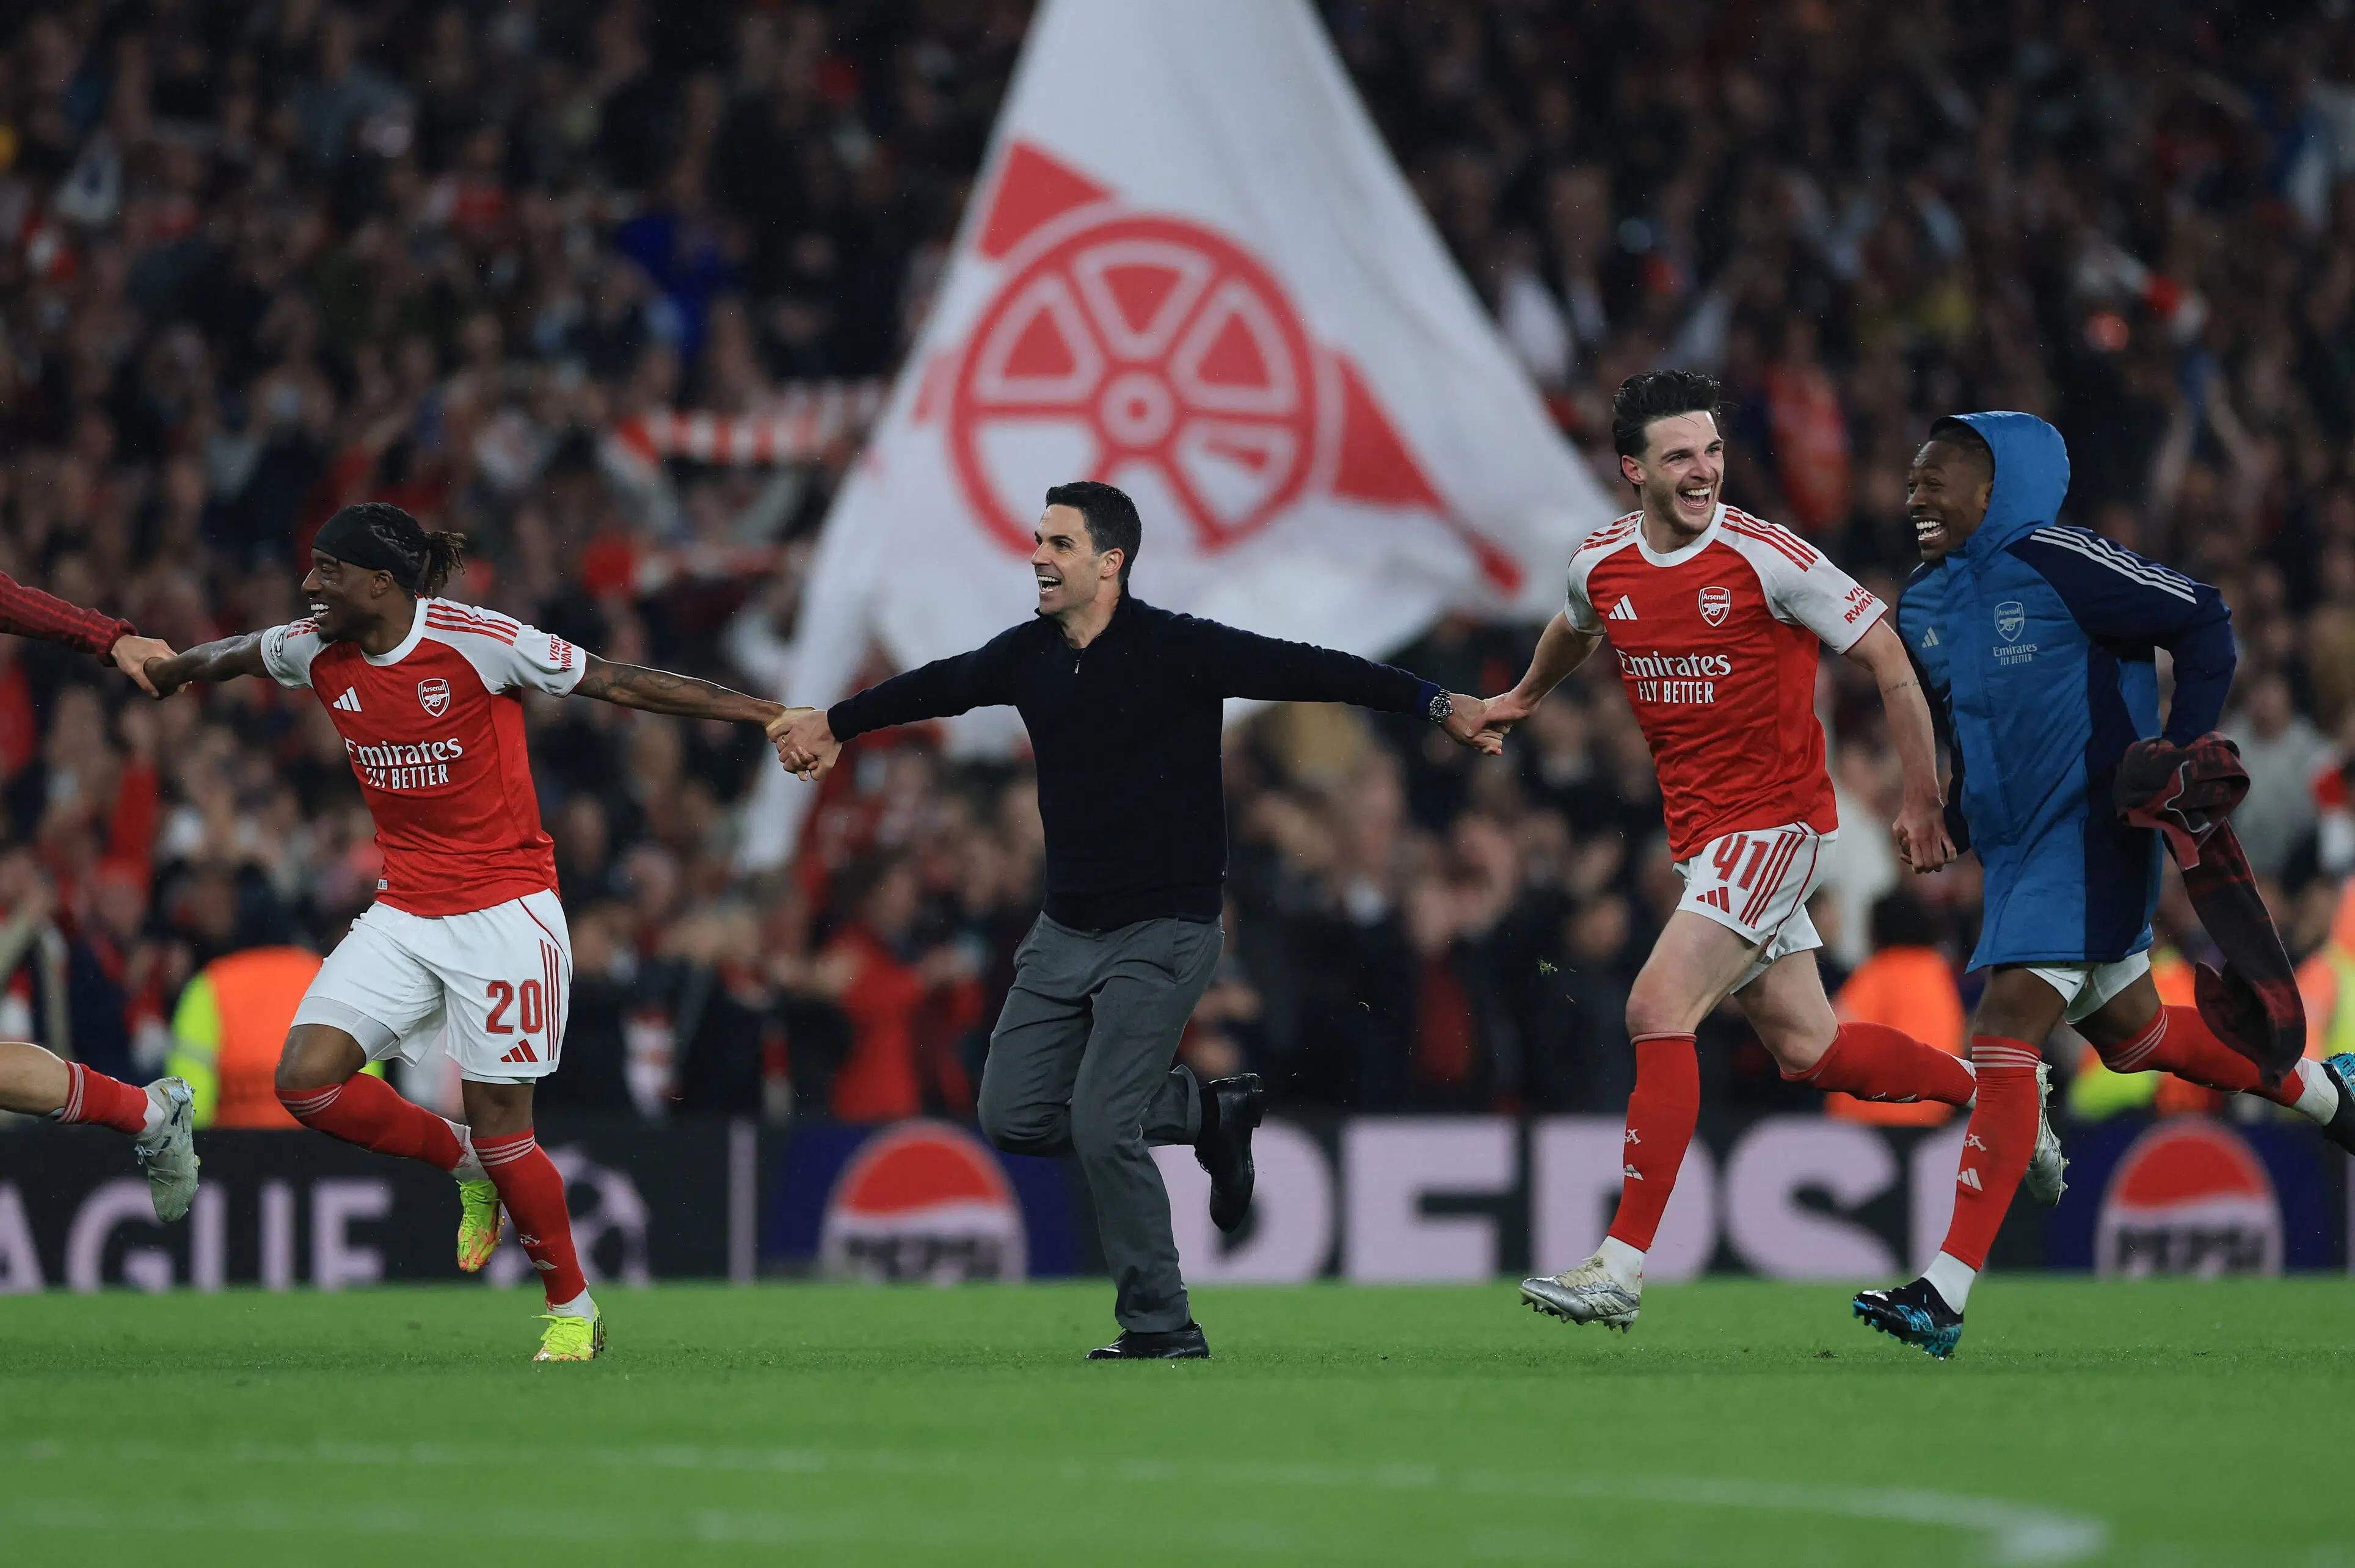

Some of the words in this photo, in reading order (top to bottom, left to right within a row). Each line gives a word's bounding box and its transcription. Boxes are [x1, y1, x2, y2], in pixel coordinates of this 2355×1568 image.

[1844, 586, 1865, 602] VIS
[1844, 593, 1876, 624] RWAN
[550, 635, 560, 660] VISIT
[559, 641, 572, 672] RWAN
[1993, 644, 2037, 657] Emirates
[2000, 656, 2009, 666] FLY
[2011, 653, 2033, 664] BETTER
[1616, 650, 1731, 678] Emirates
[423, 684, 445, 693] Arsenal
[1637, 681, 1657, 702] FLY
[1663, 681, 1714, 703] BETTER
[344, 737, 463, 766] Emirates
[391, 764, 450, 789] BETTER
[1713, 833, 1771, 891] 41
[486, 979, 544, 1035] 20
